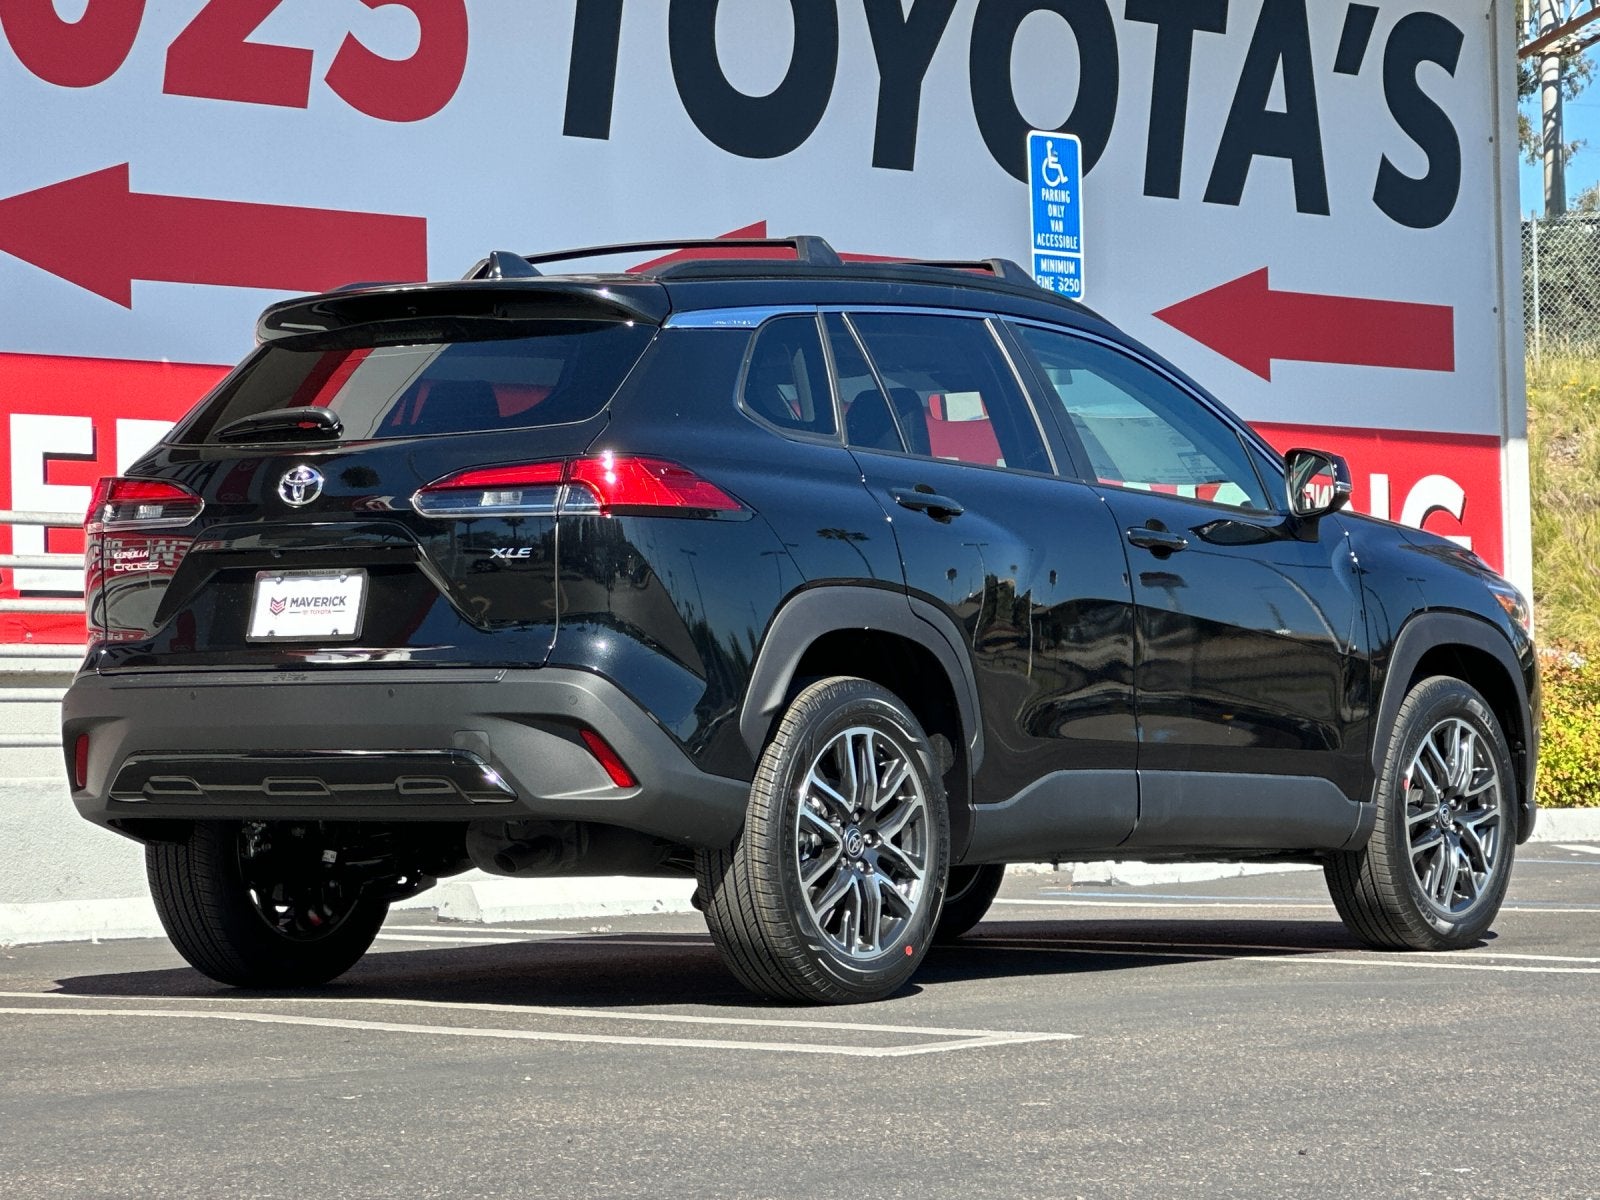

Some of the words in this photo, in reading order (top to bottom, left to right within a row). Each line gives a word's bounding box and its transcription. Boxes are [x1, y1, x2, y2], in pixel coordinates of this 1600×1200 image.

[1041, 188, 1071, 204] PARKING
[1047, 204, 1065, 218] ONLY
[1050, 220, 1064, 233] VAN
[1036, 233, 1078, 249] ACCESSIBLE
[1040, 258, 1076, 274] MINIMUM
[489, 547, 532, 559] XLE
[113, 561, 159, 571] CROSS
[290, 595, 347, 608] MAVERICK
